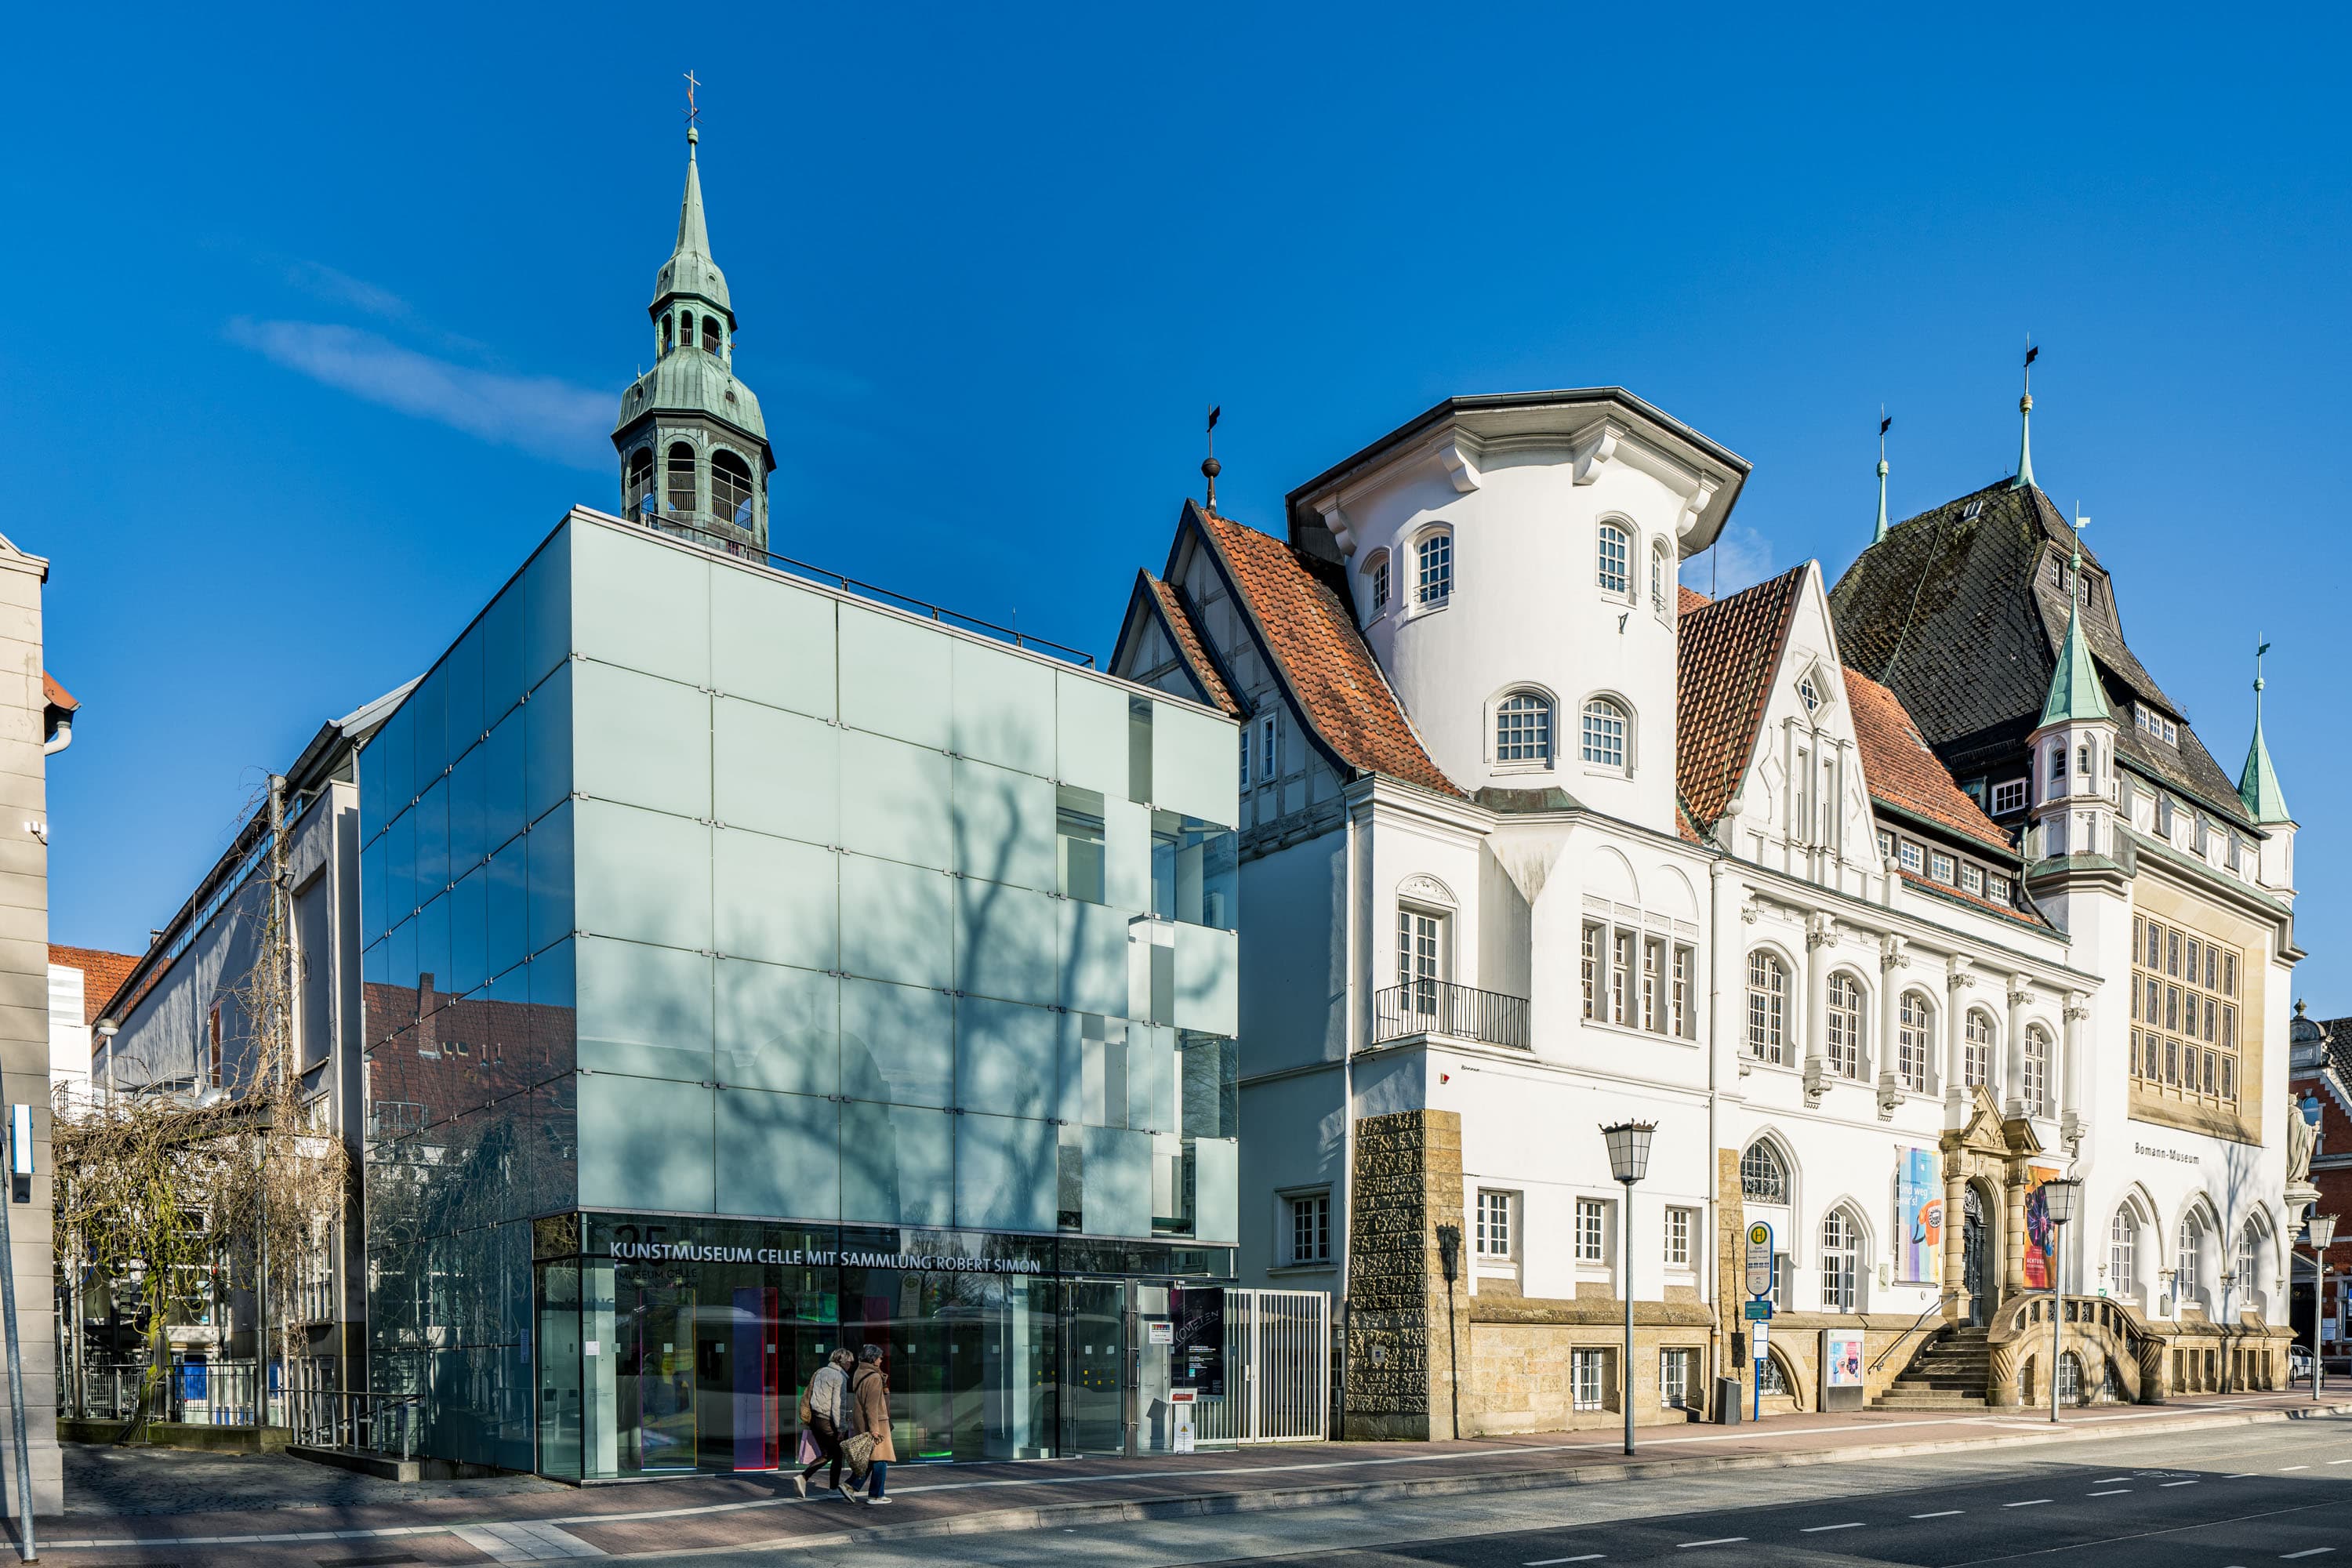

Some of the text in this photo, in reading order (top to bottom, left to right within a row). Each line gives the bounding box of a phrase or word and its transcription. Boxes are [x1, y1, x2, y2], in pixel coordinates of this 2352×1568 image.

[2135, 1142, 2200, 1165] Bomann-Museum
[1900, 1184, 1928, 1200] Und weg
[610, 1241, 1040, 1274] KUNSTMUSEUM CELLE MIT SAMMLUNG ROBERT SIMON
[615, 1269, 664, 1280] TMUSEUM
